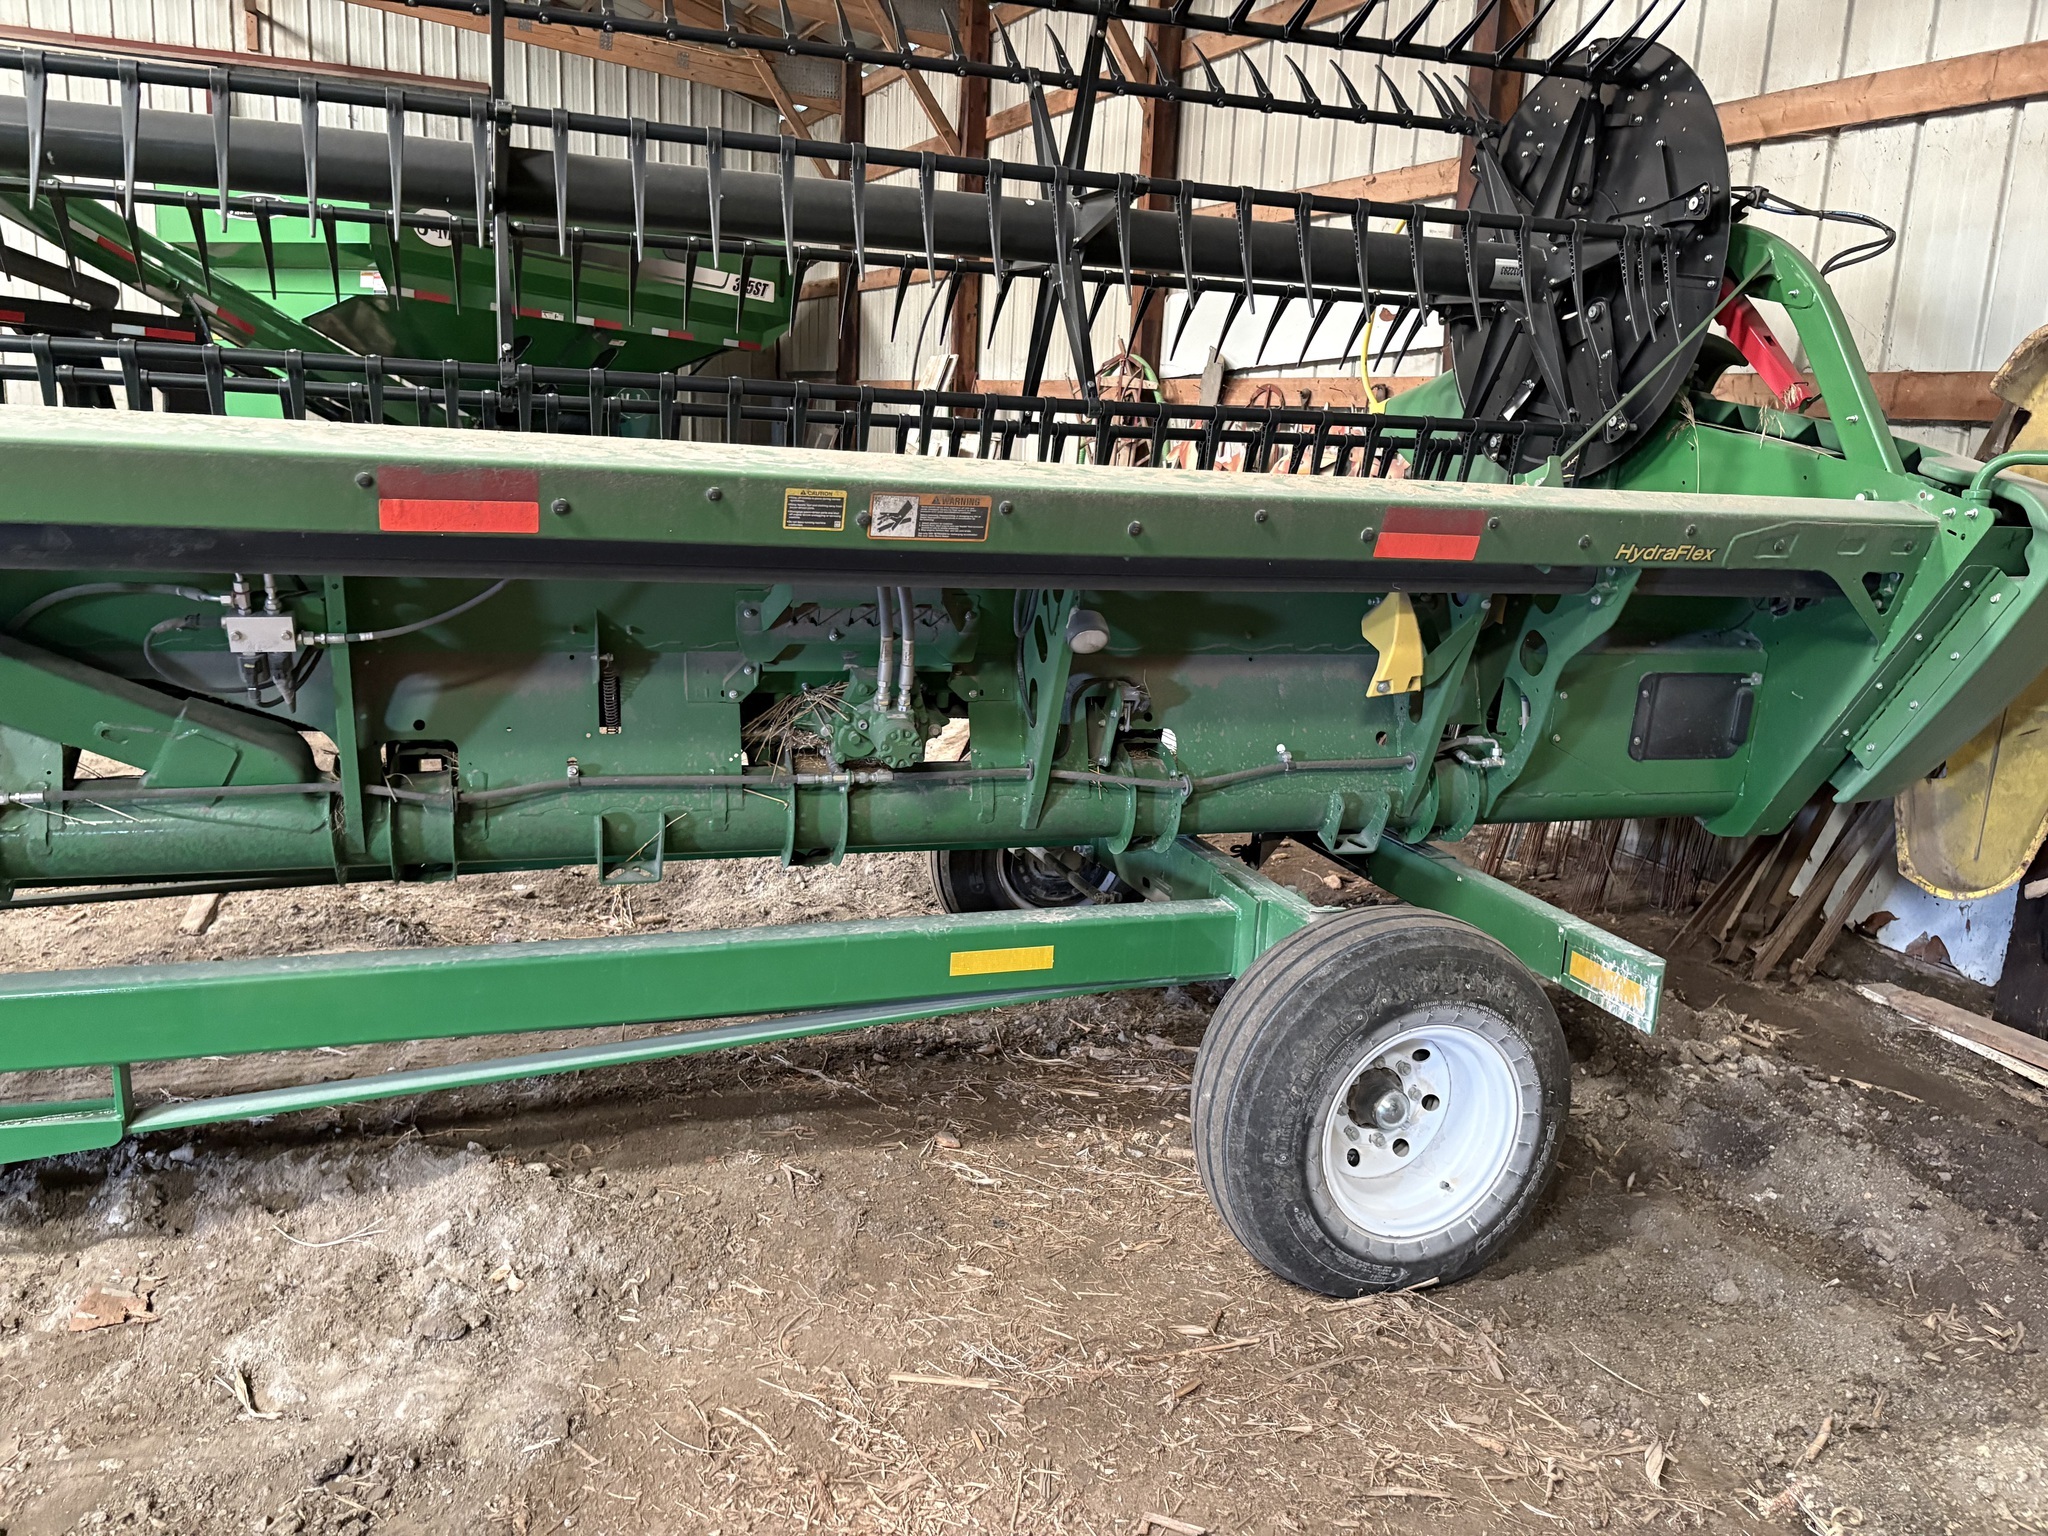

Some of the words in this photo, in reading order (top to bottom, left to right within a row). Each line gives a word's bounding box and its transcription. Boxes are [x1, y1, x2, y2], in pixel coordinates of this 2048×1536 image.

[733, 277, 769, 297] 35ST
[942, 497, 981, 506] WARNING
[1614, 543, 1717, 564] HydraFlex
